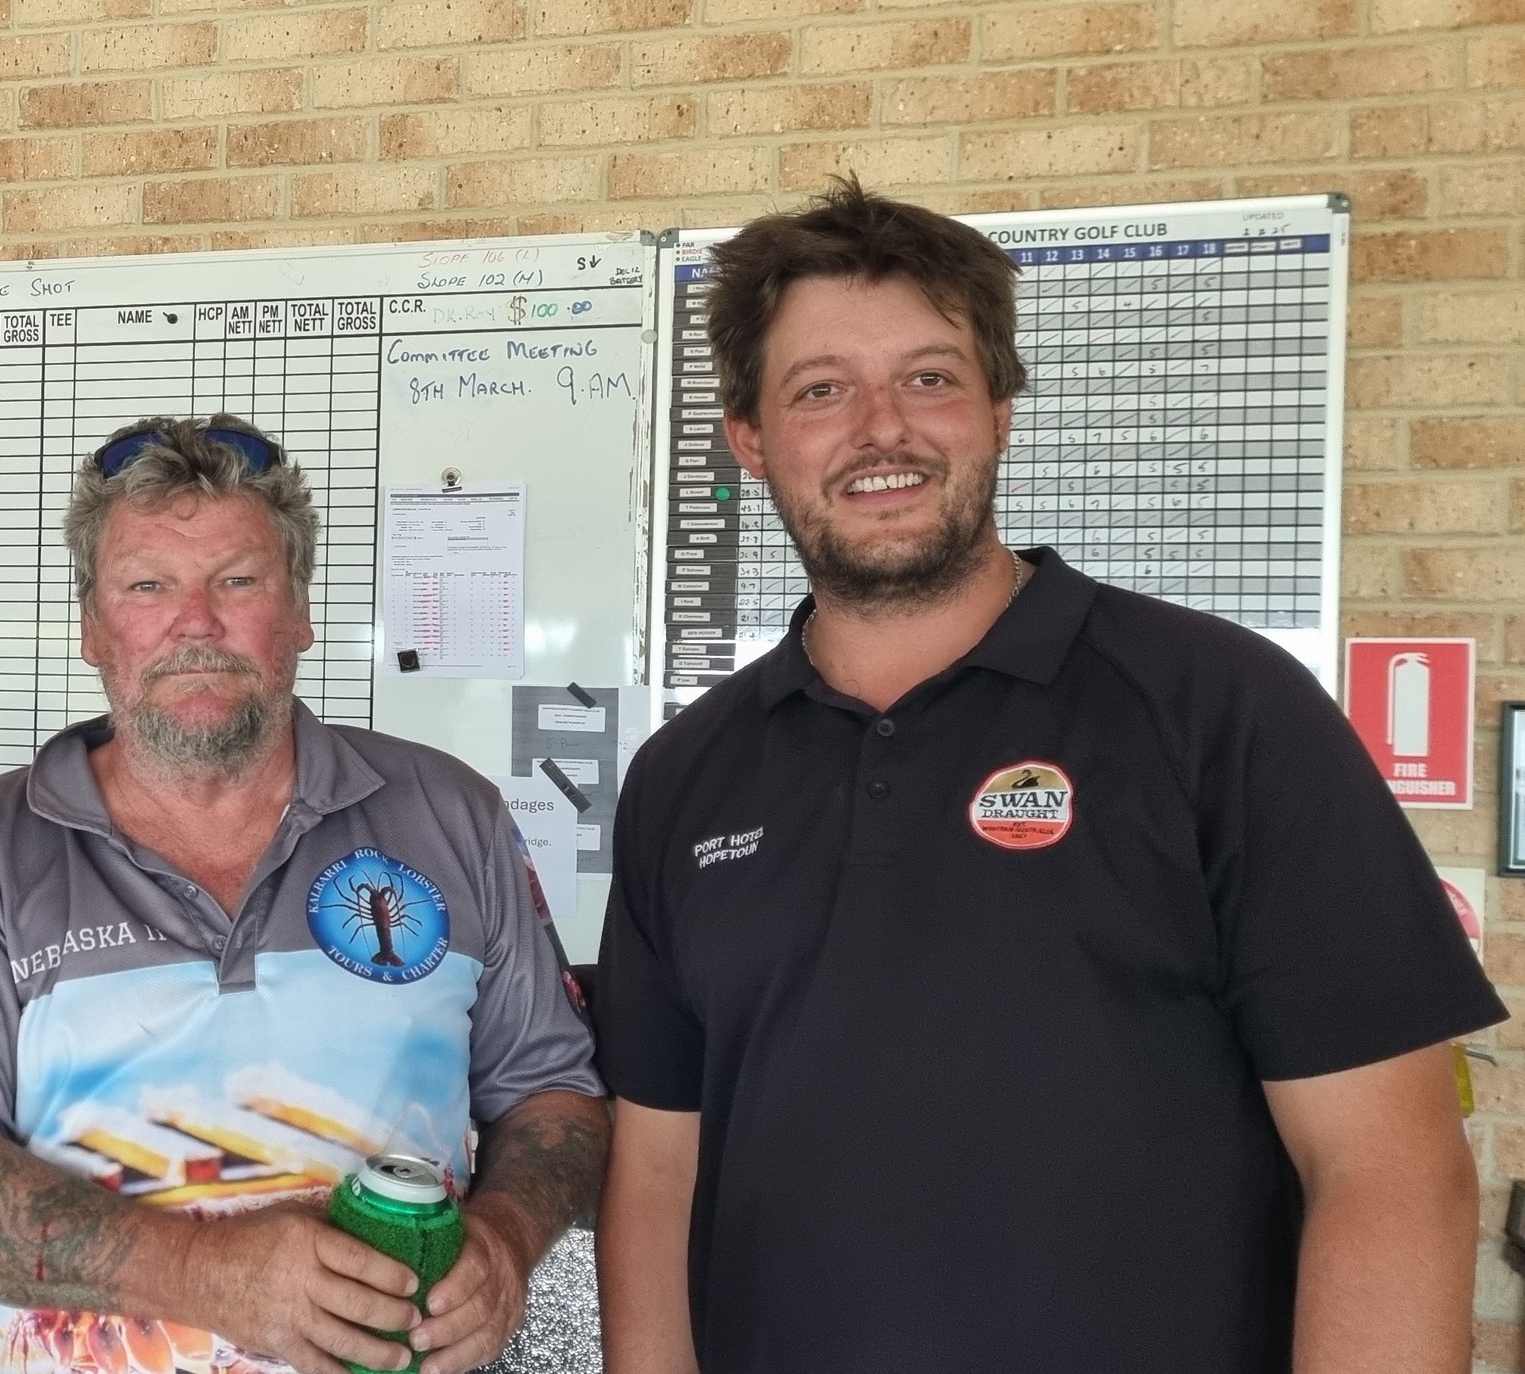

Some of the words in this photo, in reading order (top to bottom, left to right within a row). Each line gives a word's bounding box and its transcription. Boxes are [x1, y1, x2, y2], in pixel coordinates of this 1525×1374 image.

[987, 228, 1069, 245] COUNTRY
[1074, 225, 1119, 240] GOLF
[1124, 222, 1167, 237] CLUB
[1070, 249, 1084, 260] 13
[1097, 248, 1110, 259] 14
[1124, 248, 1136, 258] 15
[1150, 246, 1162, 256] 16
[1177, 245, 1189, 255] 17
[1203, 243, 1216, 254] 18
[1020, 252, 1033, 262] 11
[1045, 251, 1058, 261] 12
[479, 273, 505, 286] 102
[30, 278, 75, 297] SHOT
[231, 306, 249, 320] AM
[262, 305, 279, 319] PM
[290, 303, 329, 318] TOTAL
[337, 302, 376, 315] TOTAL
[389, 299, 426, 313] C.C.R.
[50, 313, 72, 327] TEE
[117, 310, 153, 324] NAME
[198, 307, 223, 320] HCP
[4, 315, 39, 328] TOTAL
[229, 321, 252, 335] NETT
[259, 319, 283, 334] NETT
[294, 318, 325, 332] NETT
[337, 316, 376, 330] GROSS
[3, 329, 39, 343] GROSS
[507, 340, 597, 359] MEETING
[1393, 763, 1428, 777] FIRE
[979, 791, 1068, 808] SWAN
[981, 809, 1058, 819] DRAUGHT
[694, 836, 726, 857] PORT
[699, 840, 759, 869] HOPETOUN
[308, 860, 348, 914] KALBARRI
[354, 848, 389, 865] ROCK
[398, 863, 446, 912] LOBSTER
[328, 945, 372, 977] TOURS
[382, 971, 393, 982] &
[402, 937, 448, 981] CHARTER
